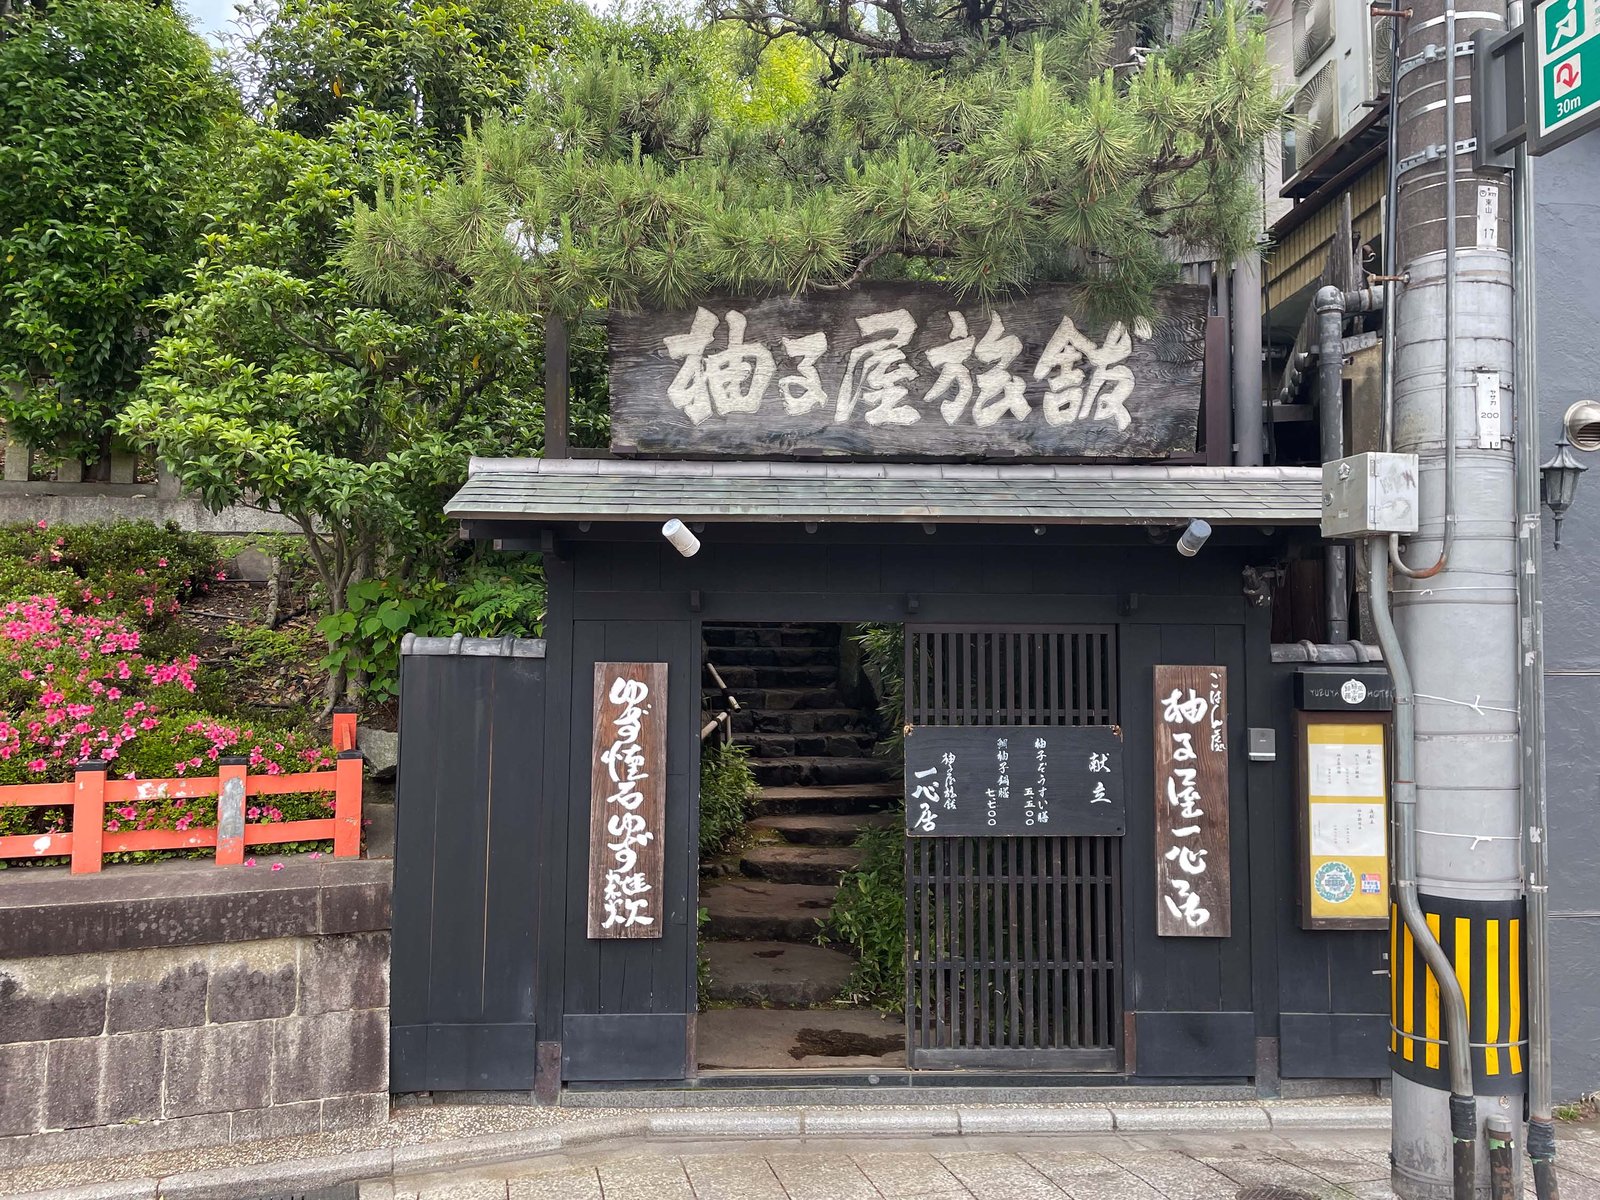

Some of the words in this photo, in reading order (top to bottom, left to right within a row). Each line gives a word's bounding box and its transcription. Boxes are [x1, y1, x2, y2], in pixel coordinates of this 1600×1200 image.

[1556, 95, 1582, 118] 30m
[1485, 199, 1493, 214] 東山
[1484, 228, 1495, 240] 17
[1480, 411, 1500, 419] 200
[1088, 752, 1112, 804] 献立
[911, 766, 940, 832] 一心居
